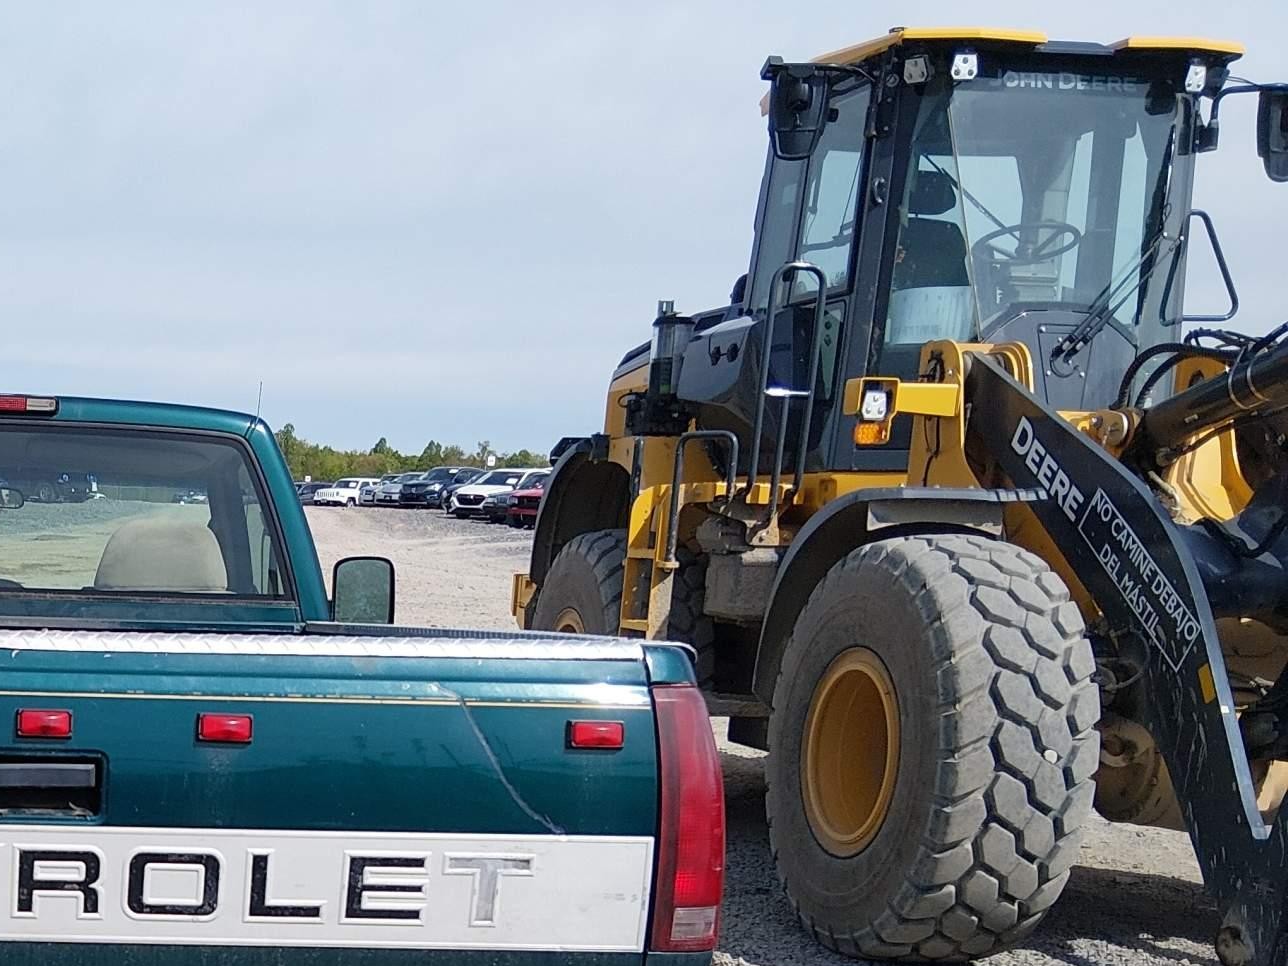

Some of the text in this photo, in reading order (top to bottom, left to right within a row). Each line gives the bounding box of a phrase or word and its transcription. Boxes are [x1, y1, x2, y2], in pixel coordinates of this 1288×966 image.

[1059, 72, 1137, 92] DEERE
[1011, 415, 1084, 522] DEERE
[1092, 490, 1198, 641] NO CAMINE DEBAJO
[1099, 543, 1160, 637] DEL MÁSTIL
